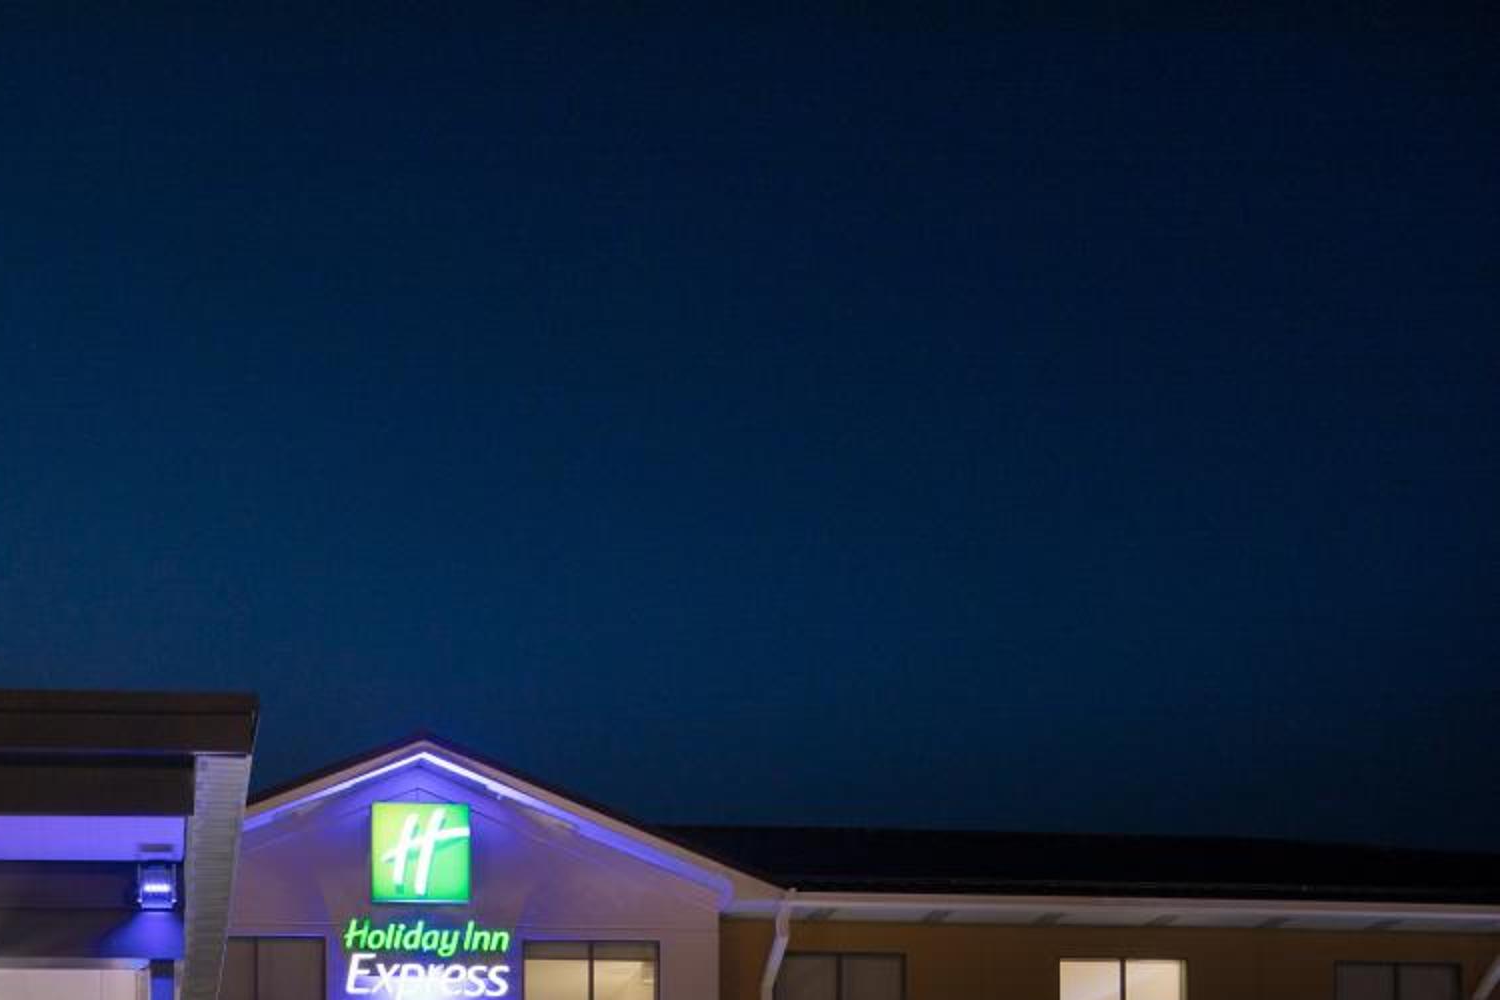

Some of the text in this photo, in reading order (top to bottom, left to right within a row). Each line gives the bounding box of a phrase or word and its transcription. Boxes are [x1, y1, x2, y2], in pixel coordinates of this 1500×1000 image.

[382, 808, 470, 895] H
[344, 919, 509, 957] Holiday Inn
